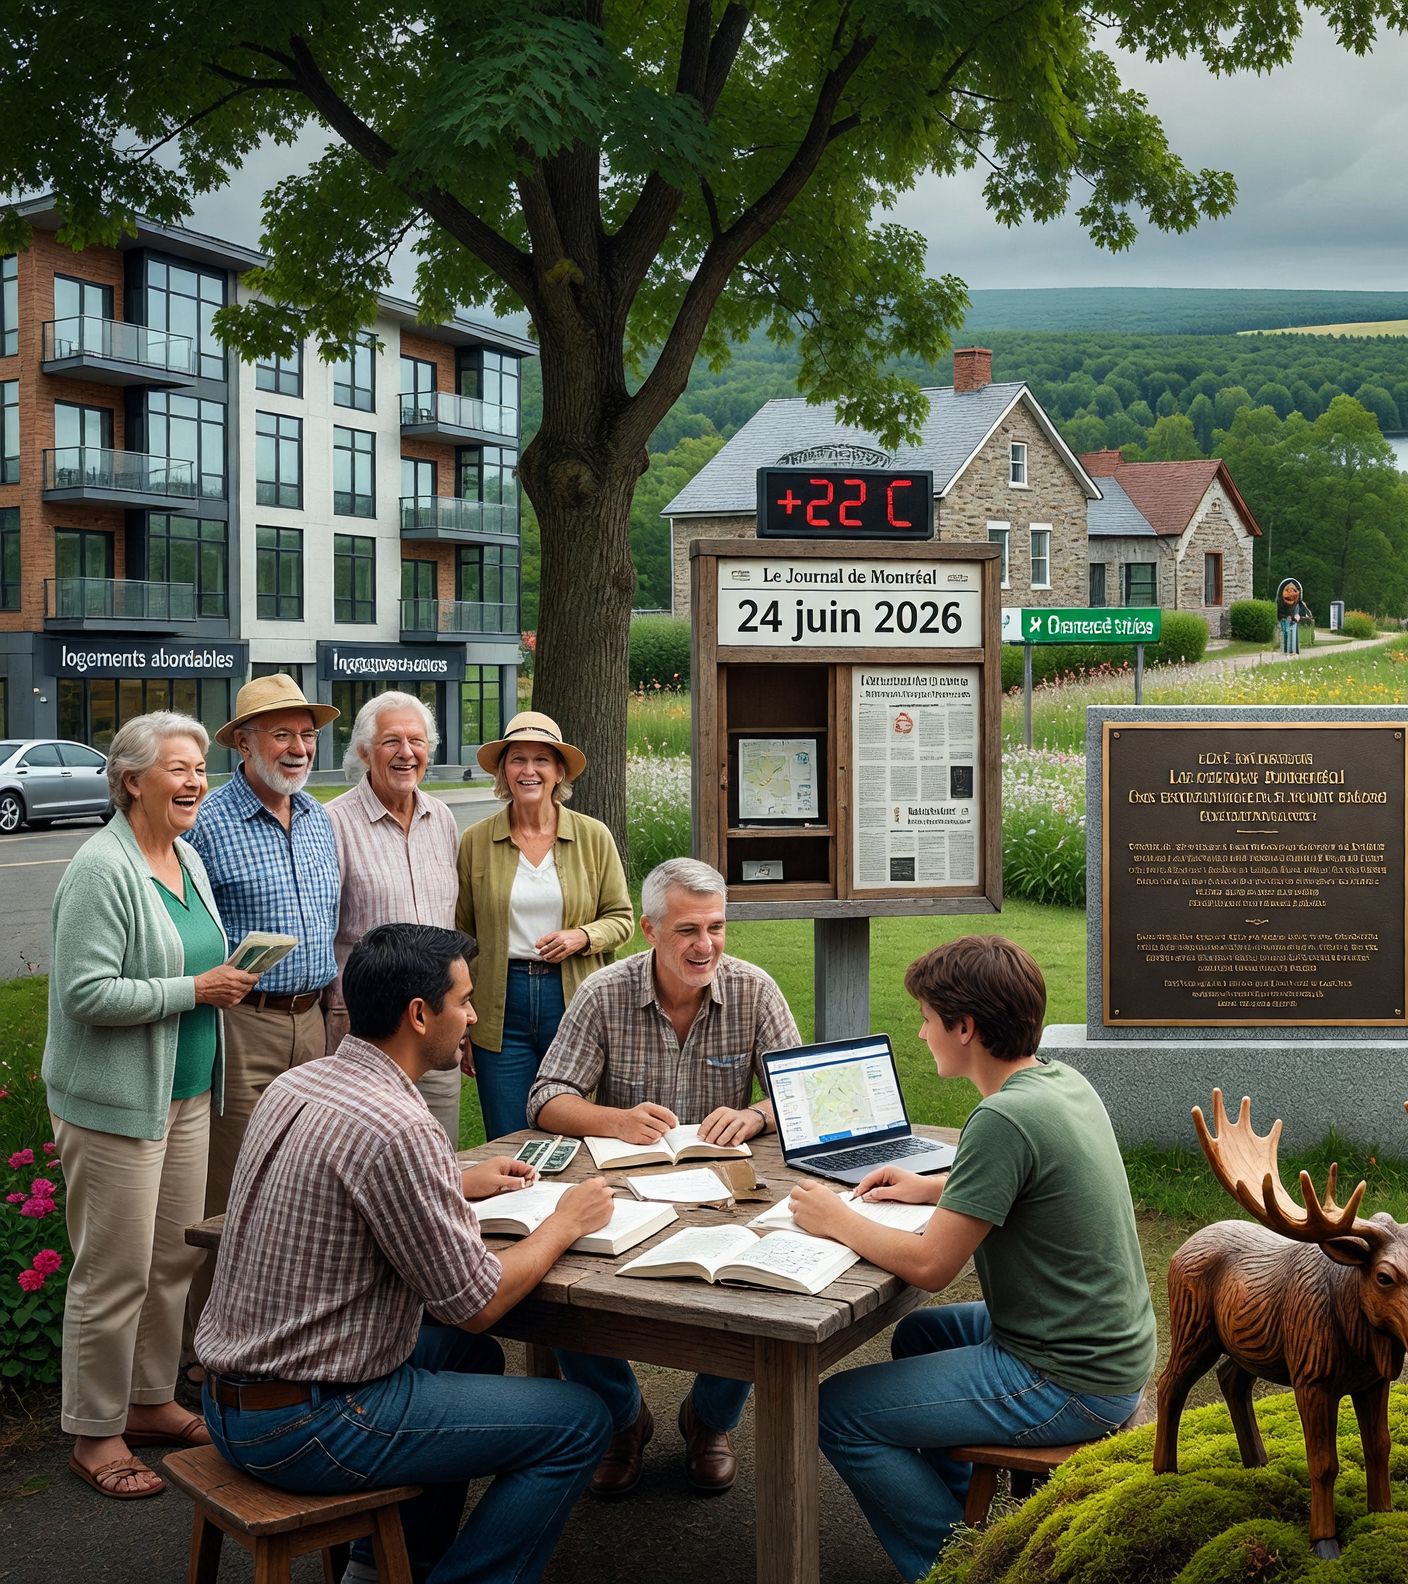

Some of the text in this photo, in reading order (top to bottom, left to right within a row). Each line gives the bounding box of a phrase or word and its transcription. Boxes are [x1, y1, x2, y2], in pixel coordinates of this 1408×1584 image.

[763, 568, 782, 584] Le
[785, 568, 843, 584] Journal
[848, 568, 866, 584] de
[871, 569, 937, 585] Montréal
[737, 599, 962, 641] 24 juin 2026
[62, 645, 234, 672] logements abordables
